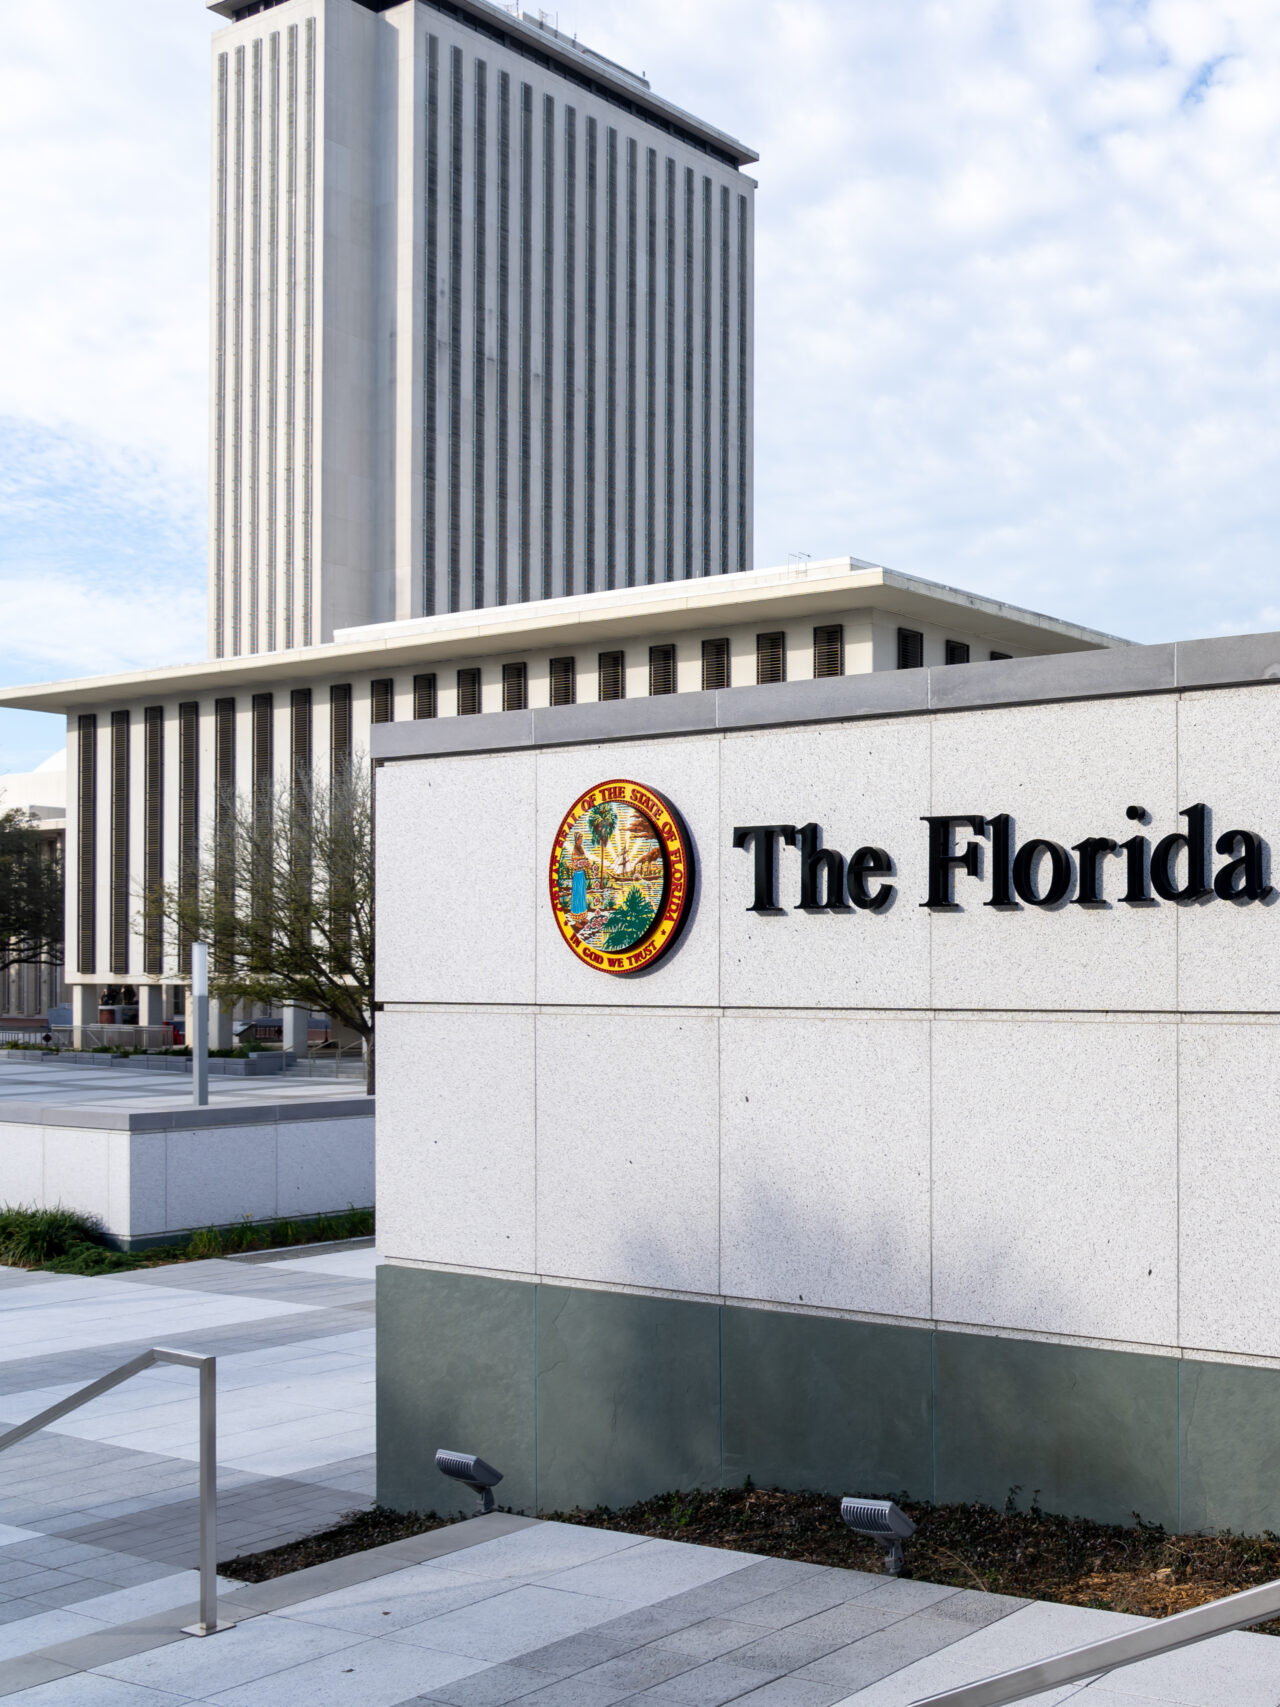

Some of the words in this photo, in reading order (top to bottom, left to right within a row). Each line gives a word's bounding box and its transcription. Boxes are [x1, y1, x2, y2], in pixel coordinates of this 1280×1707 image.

[581, 793, 597, 812] OF
[598, 786, 626, 801] THE
[630, 789, 664, 820] STATE
[662, 821, 677, 842] OF
[733, 823, 893, 914] The
[919, 804, 1274, 910] Florida
[664, 848, 683, 921] FLORIDA
[570, 932, 582, 948] IN
[582, 947, 604, 965] GOD
[607, 957, 625, 968] WE
[626, 940, 657, 966] TRUST
